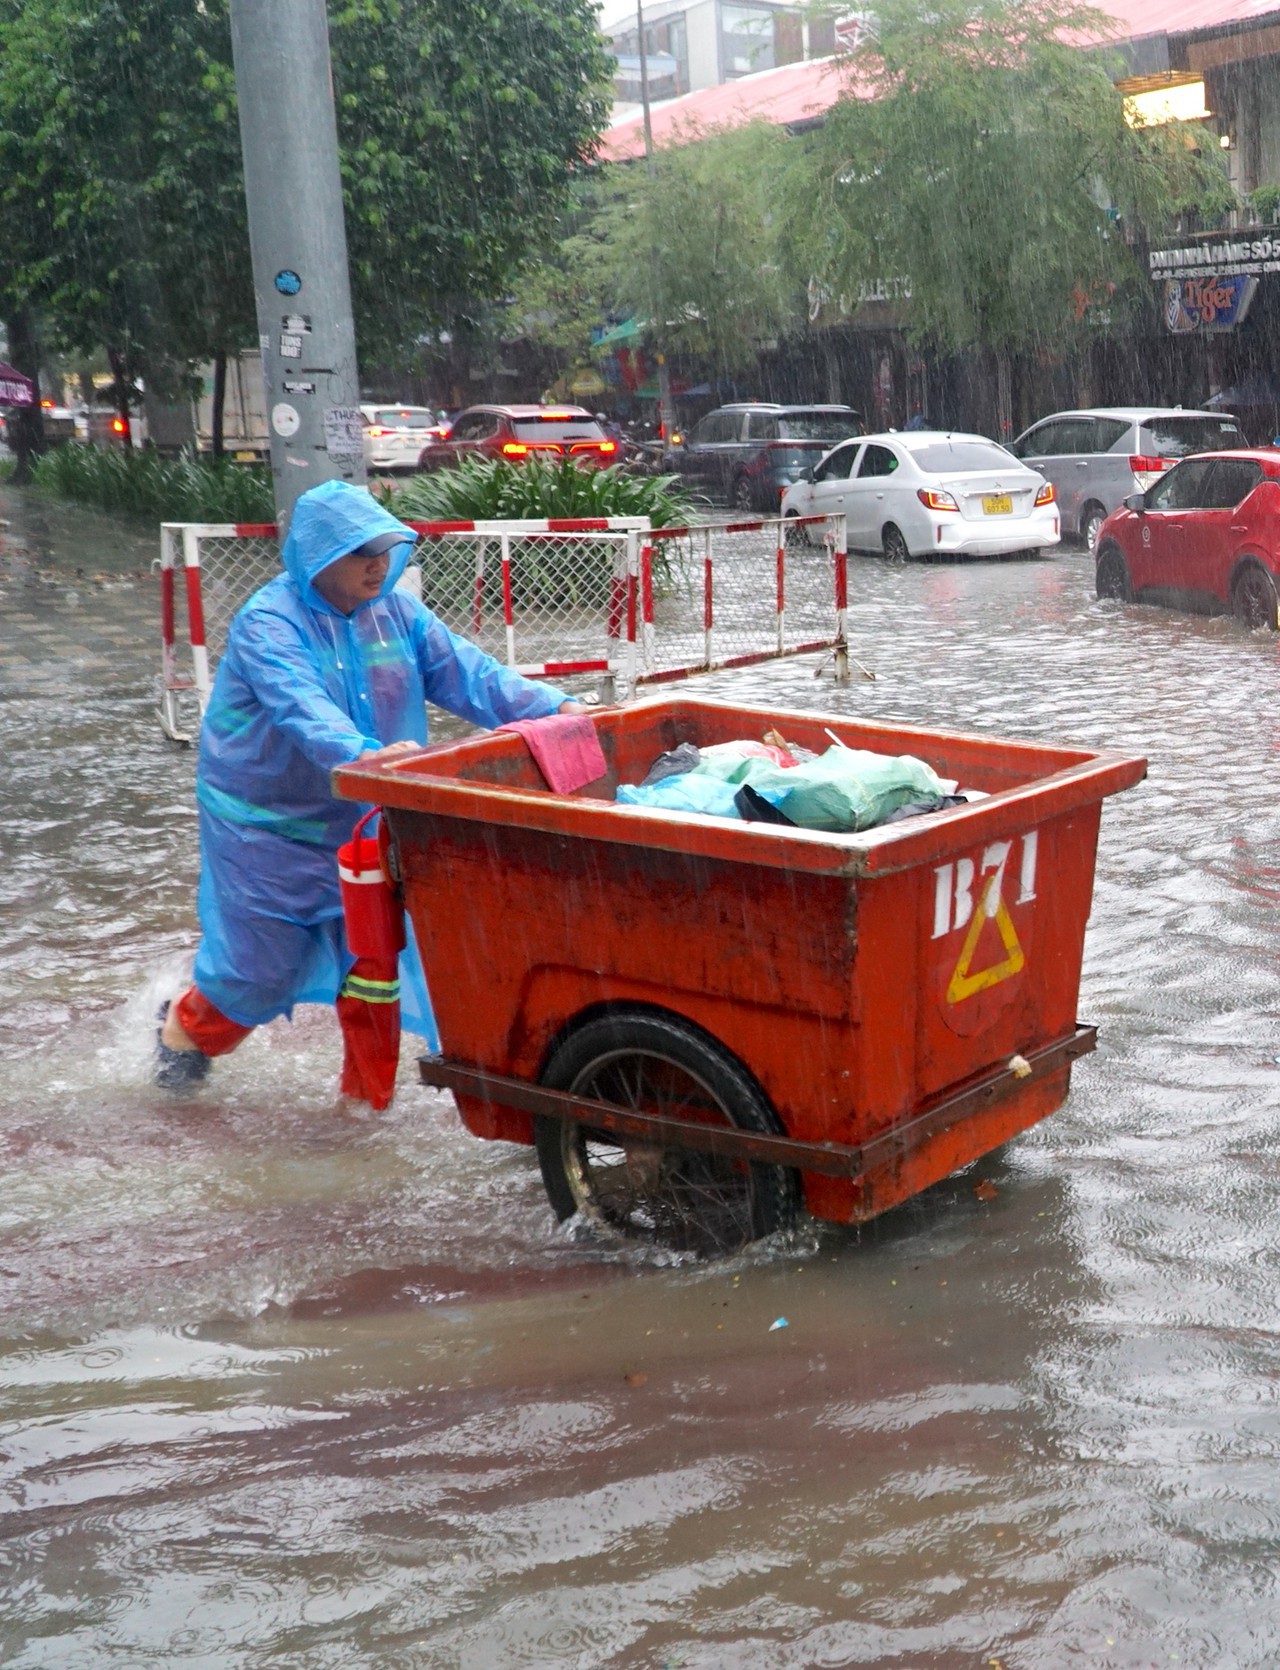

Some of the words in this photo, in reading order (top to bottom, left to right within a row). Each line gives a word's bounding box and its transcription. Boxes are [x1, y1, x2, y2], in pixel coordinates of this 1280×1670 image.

[1251, 234, 1272, 260] SỐ
[1184, 275, 1235, 323] Tiger
[931, 829, 1039, 939] B71
